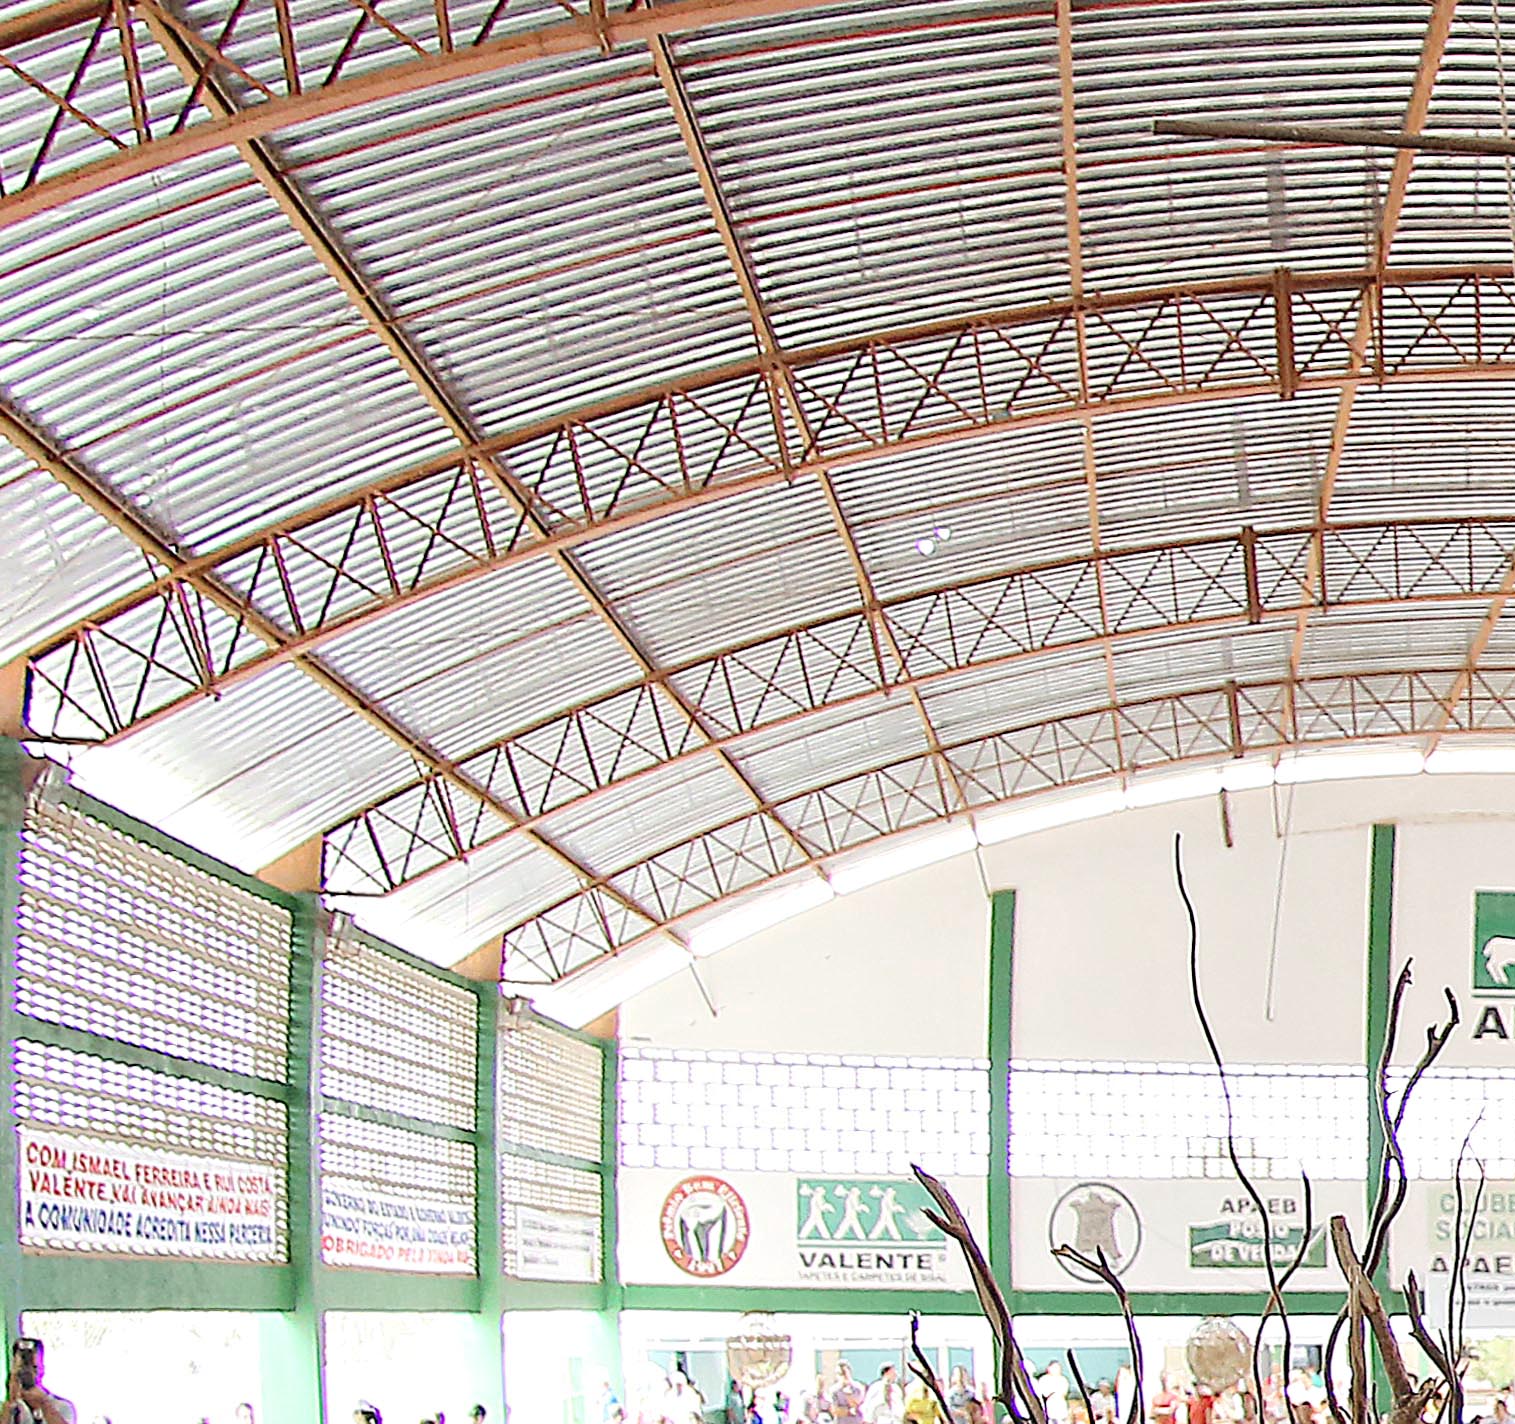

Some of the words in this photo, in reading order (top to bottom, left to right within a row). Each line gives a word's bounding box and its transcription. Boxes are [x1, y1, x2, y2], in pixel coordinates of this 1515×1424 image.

[27, 1142, 66, 1168] COM
[73, 1151, 130, 1180] ISMAEL
[135, 1163, 201, 1189] FERREIRA
[203, 1172, 211, 1190] E
[28, 1170, 108, 1201] VALENTE
[26, 1200, 35, 1227] A
[38, 1202, 132, 1237] COMUNIDADE
[136, 1213, 190, 1241] ACREDITA
[322, 1235, 394, 1260] OBRIGADO
[799, 1252, 932, 1270] VALENTE
